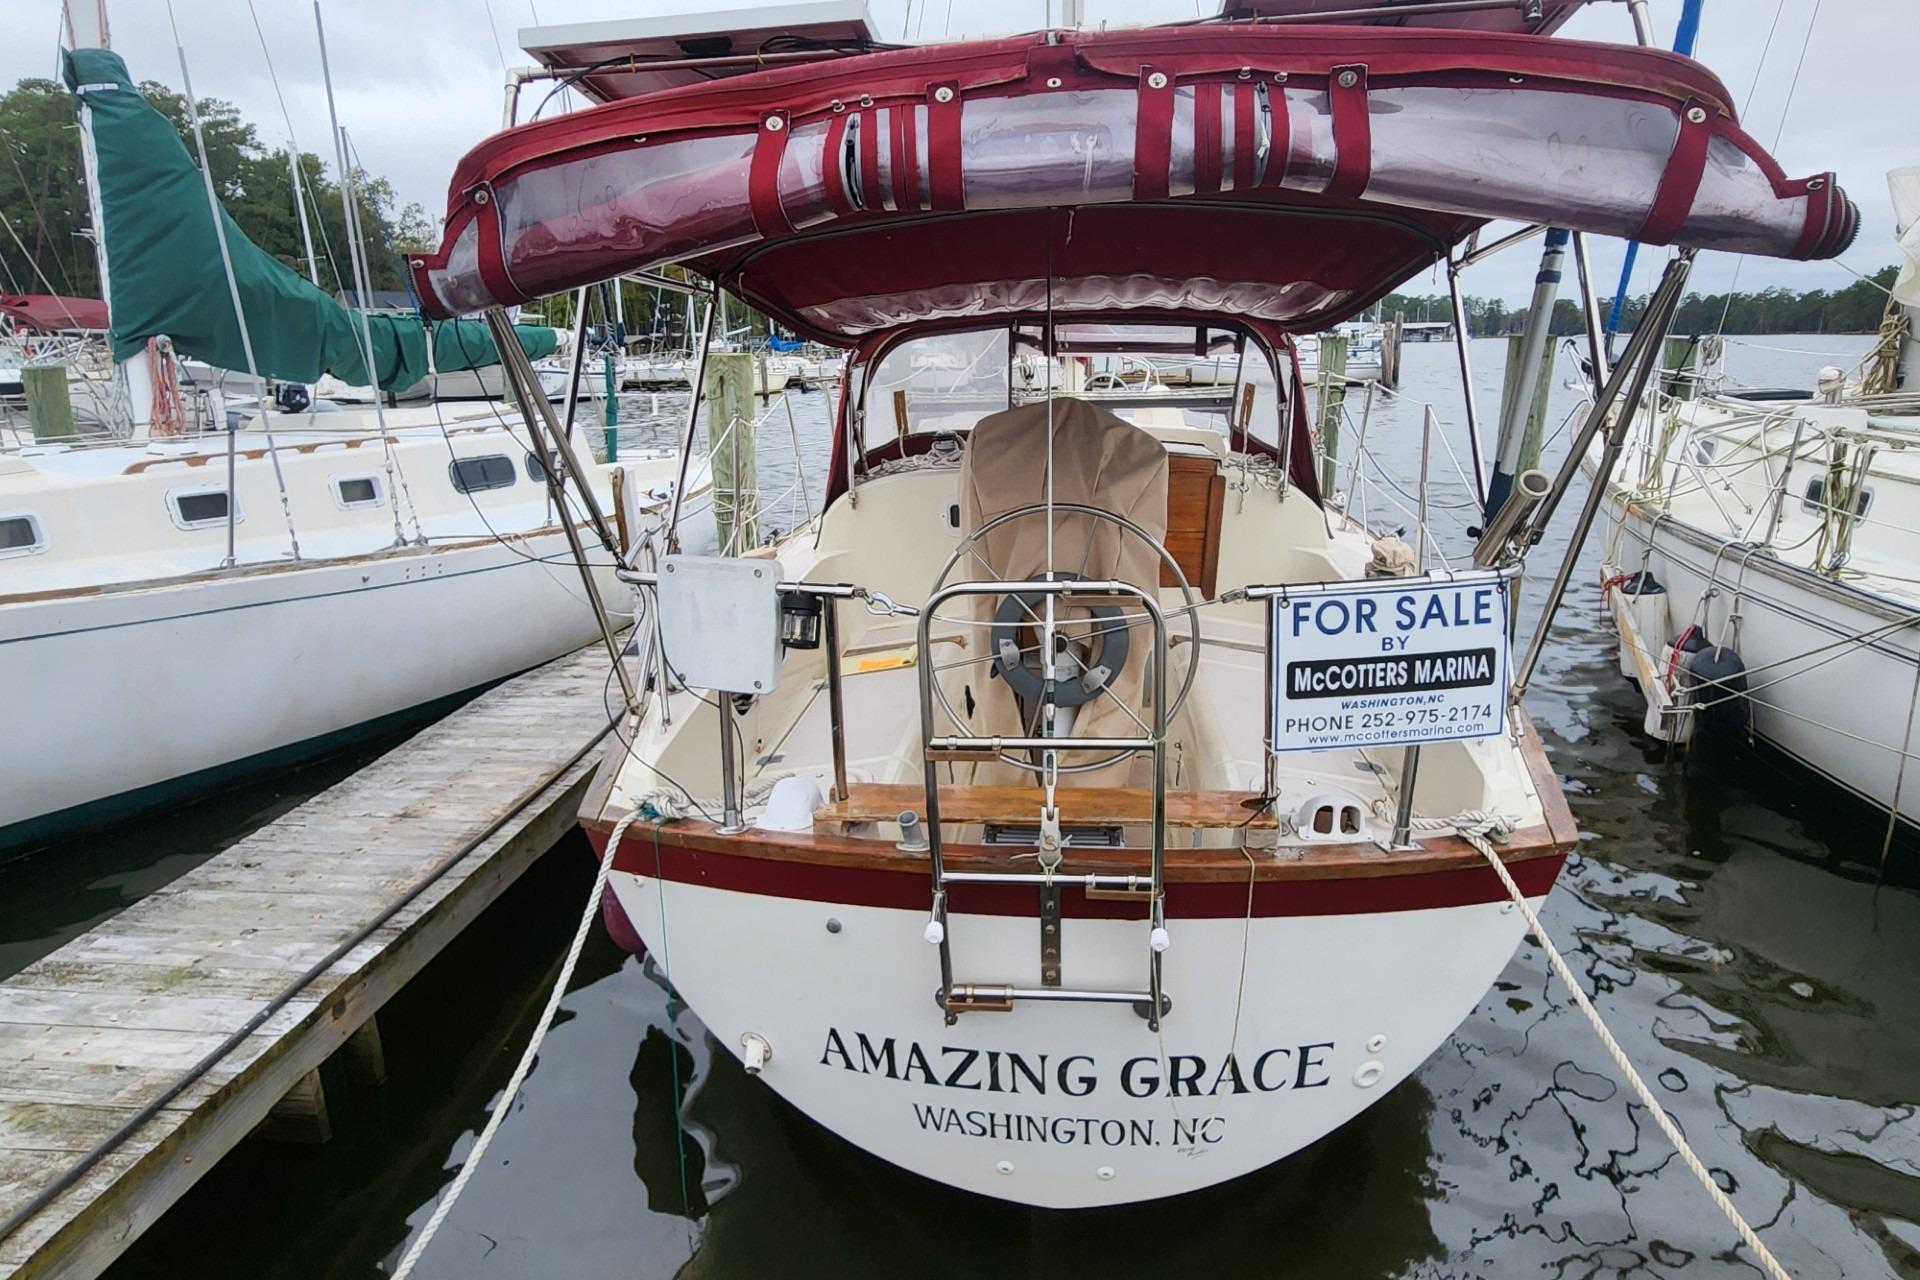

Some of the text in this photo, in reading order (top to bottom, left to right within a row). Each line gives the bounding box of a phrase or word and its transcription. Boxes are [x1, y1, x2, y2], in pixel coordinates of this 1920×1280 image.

[1293, 589, 1492, 637] FOR SALE
[1381, 635, 1410, 651] BY
[1294, 654, 1490, 692] McCOTTERS MARINA
[1286, 704, 1492, 733] PHONE 252-975-2174
[1308, 722, 1484, 744] www.mccottersmarina.com
[819, 1027, 1334, 1098] AMAZING GRACE
[1172, 1117, 1226, 1145] NC
